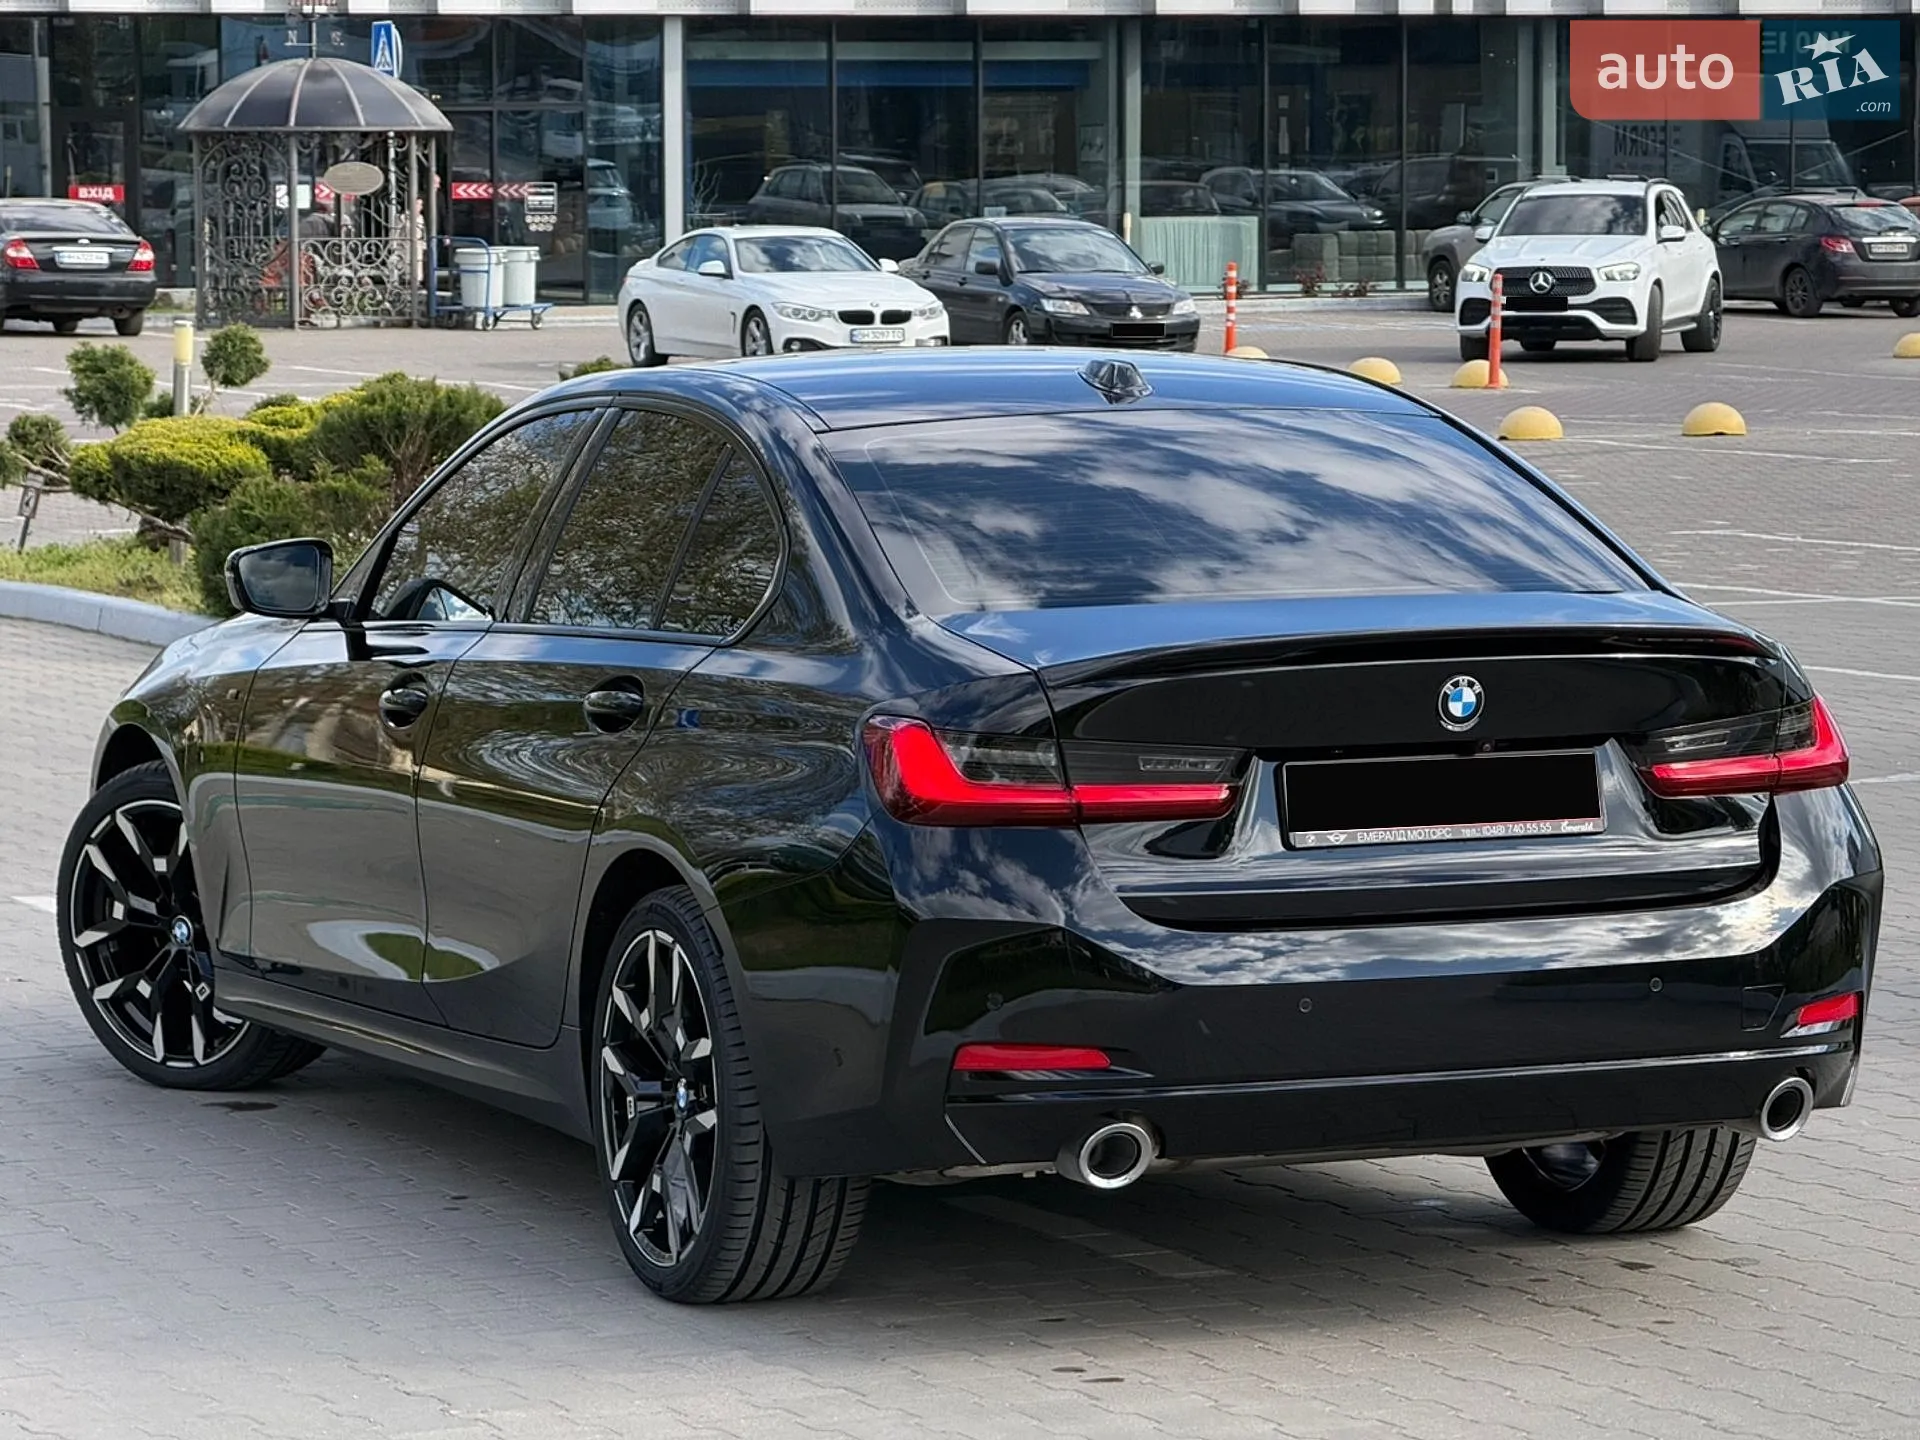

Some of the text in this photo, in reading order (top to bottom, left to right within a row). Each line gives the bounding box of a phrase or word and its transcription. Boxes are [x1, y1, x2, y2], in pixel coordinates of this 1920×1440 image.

[78, 187, 115, 200] ВХІД
[1357, 829, 1407, 842] ЕМЕРАЛД
[1408, 828, 1452, 840] МОТОРС
[1508, 824, 1524, 834] 740
[1526, 823, 1539, 832] 55
[1540, 822, 1552, 832] 55
